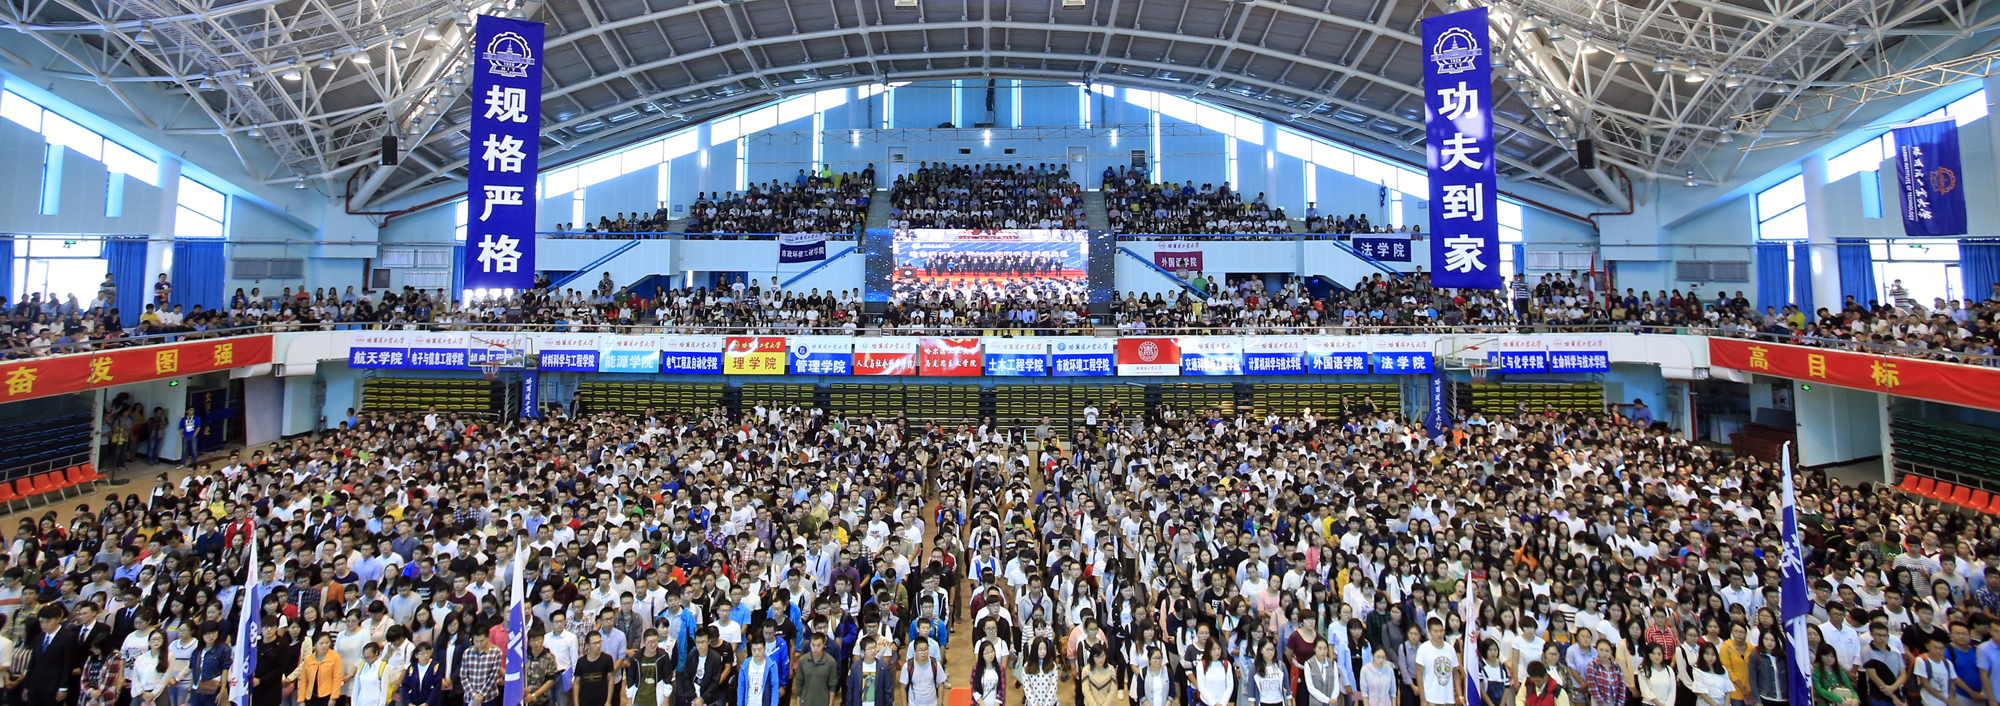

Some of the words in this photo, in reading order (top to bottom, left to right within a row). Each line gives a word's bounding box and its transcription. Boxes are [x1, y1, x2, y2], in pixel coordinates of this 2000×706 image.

[477, 84, 528, 273] 规格严格
[1437, 81, 1487, 274] 功夫到家
[1907, 192, 1915, 221] TECHNOLOGY
[1361, 243, 1405, 257] 法学院
[353, 351, 403, 366] 航天学院
[411, 352, 464, 366] 电子与信息工程学院
[541, 353, 595, 368] 材料科学与工程学院
[604, 354, 654, 369] 能源学院
[665, 356, 718, 370] 电气工程及自动化学院
[732, 356, 777, 370] 理学院
[924, 358, 977, 368] 马克思主义学院
[988, 357, 1044, 372] 土木工程学院
[1056, 358, 1110, 372] 市政环境工程学院
[1185, 357, 1241, 371] 交通科学与工程学院
[1248, 357, 1301, 371] 计算机科学与技术学院
[1313, 356, 1363, 370] 外国语学院
[1381, 355, 1426, 369] 法学院
[1552, 355, 1607, 369] 生命科学与技术学院
[5, 342, 233, 396] 奋发图强
[795, 359, 846, 374] 管理学院
[1748, 345, 1900, 388] 高目标
